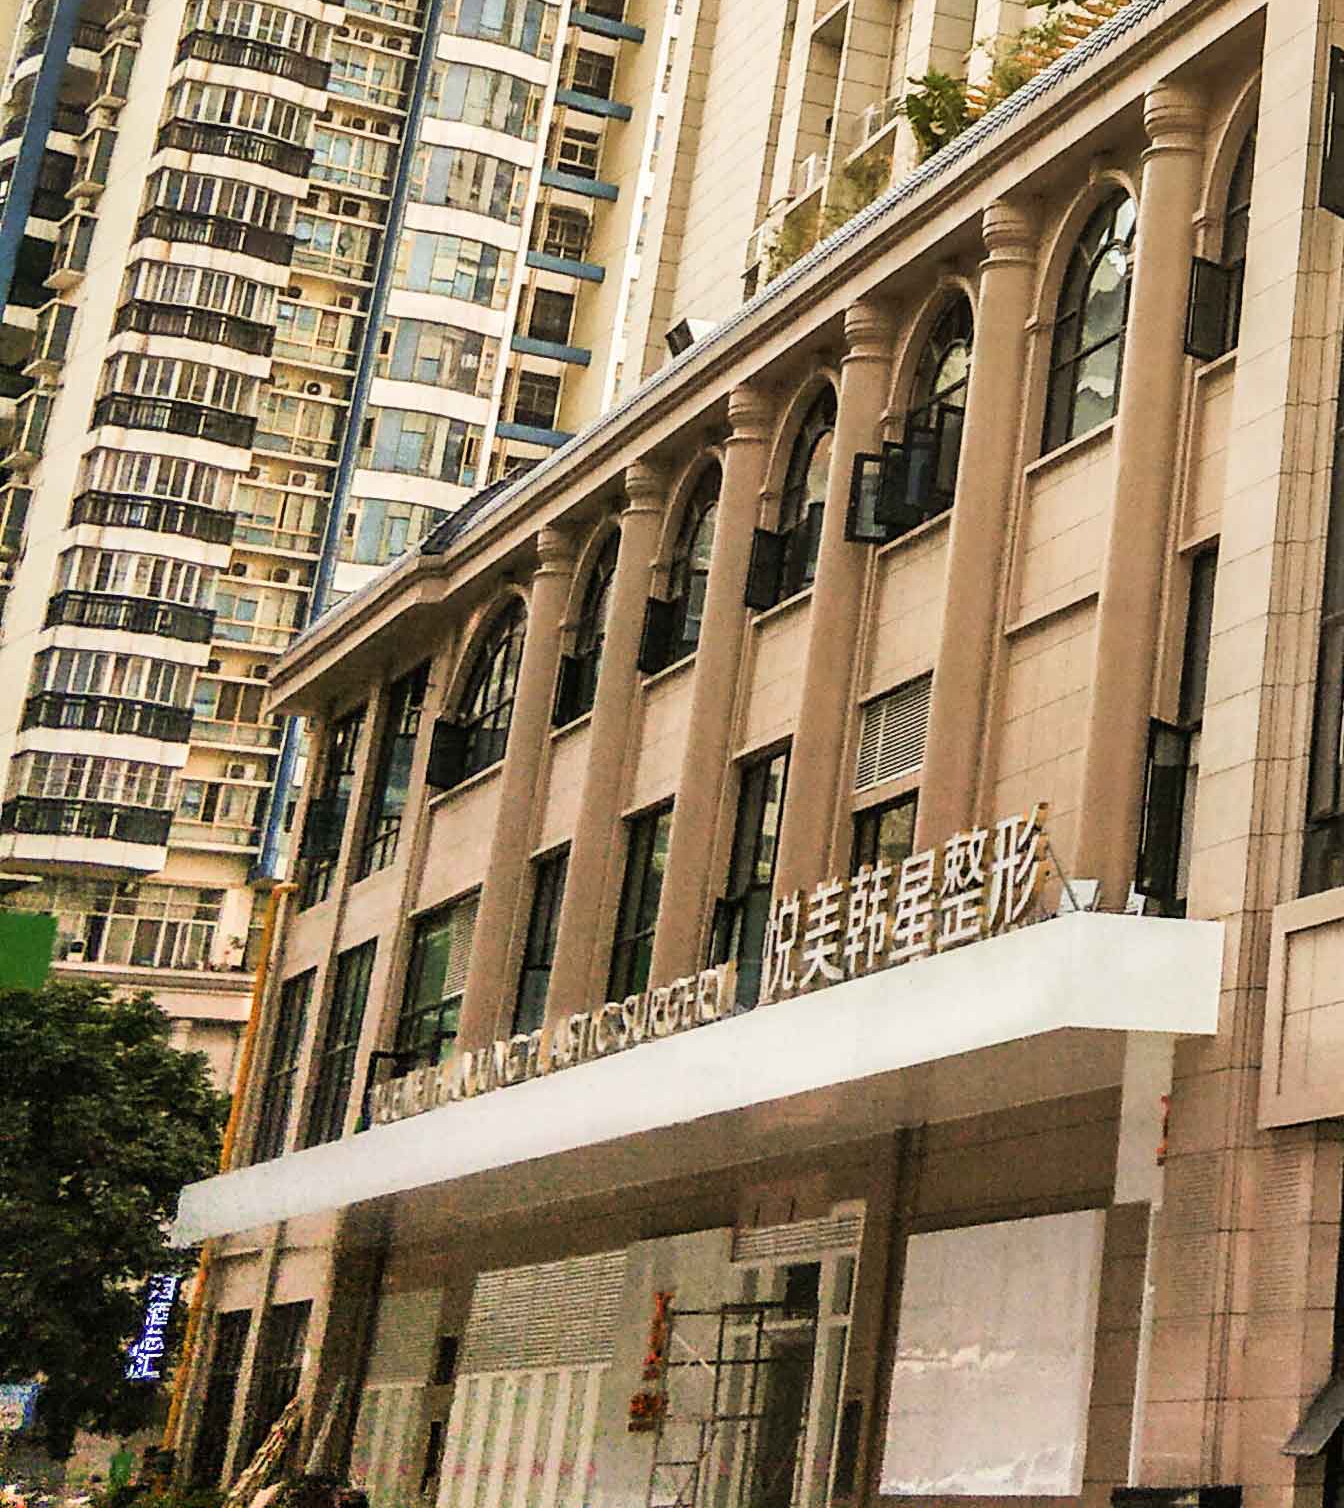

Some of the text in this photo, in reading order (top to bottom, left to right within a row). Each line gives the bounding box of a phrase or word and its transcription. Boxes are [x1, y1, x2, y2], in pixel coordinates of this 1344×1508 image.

[763, 802, 1048, 997] 悦美韩星整形
